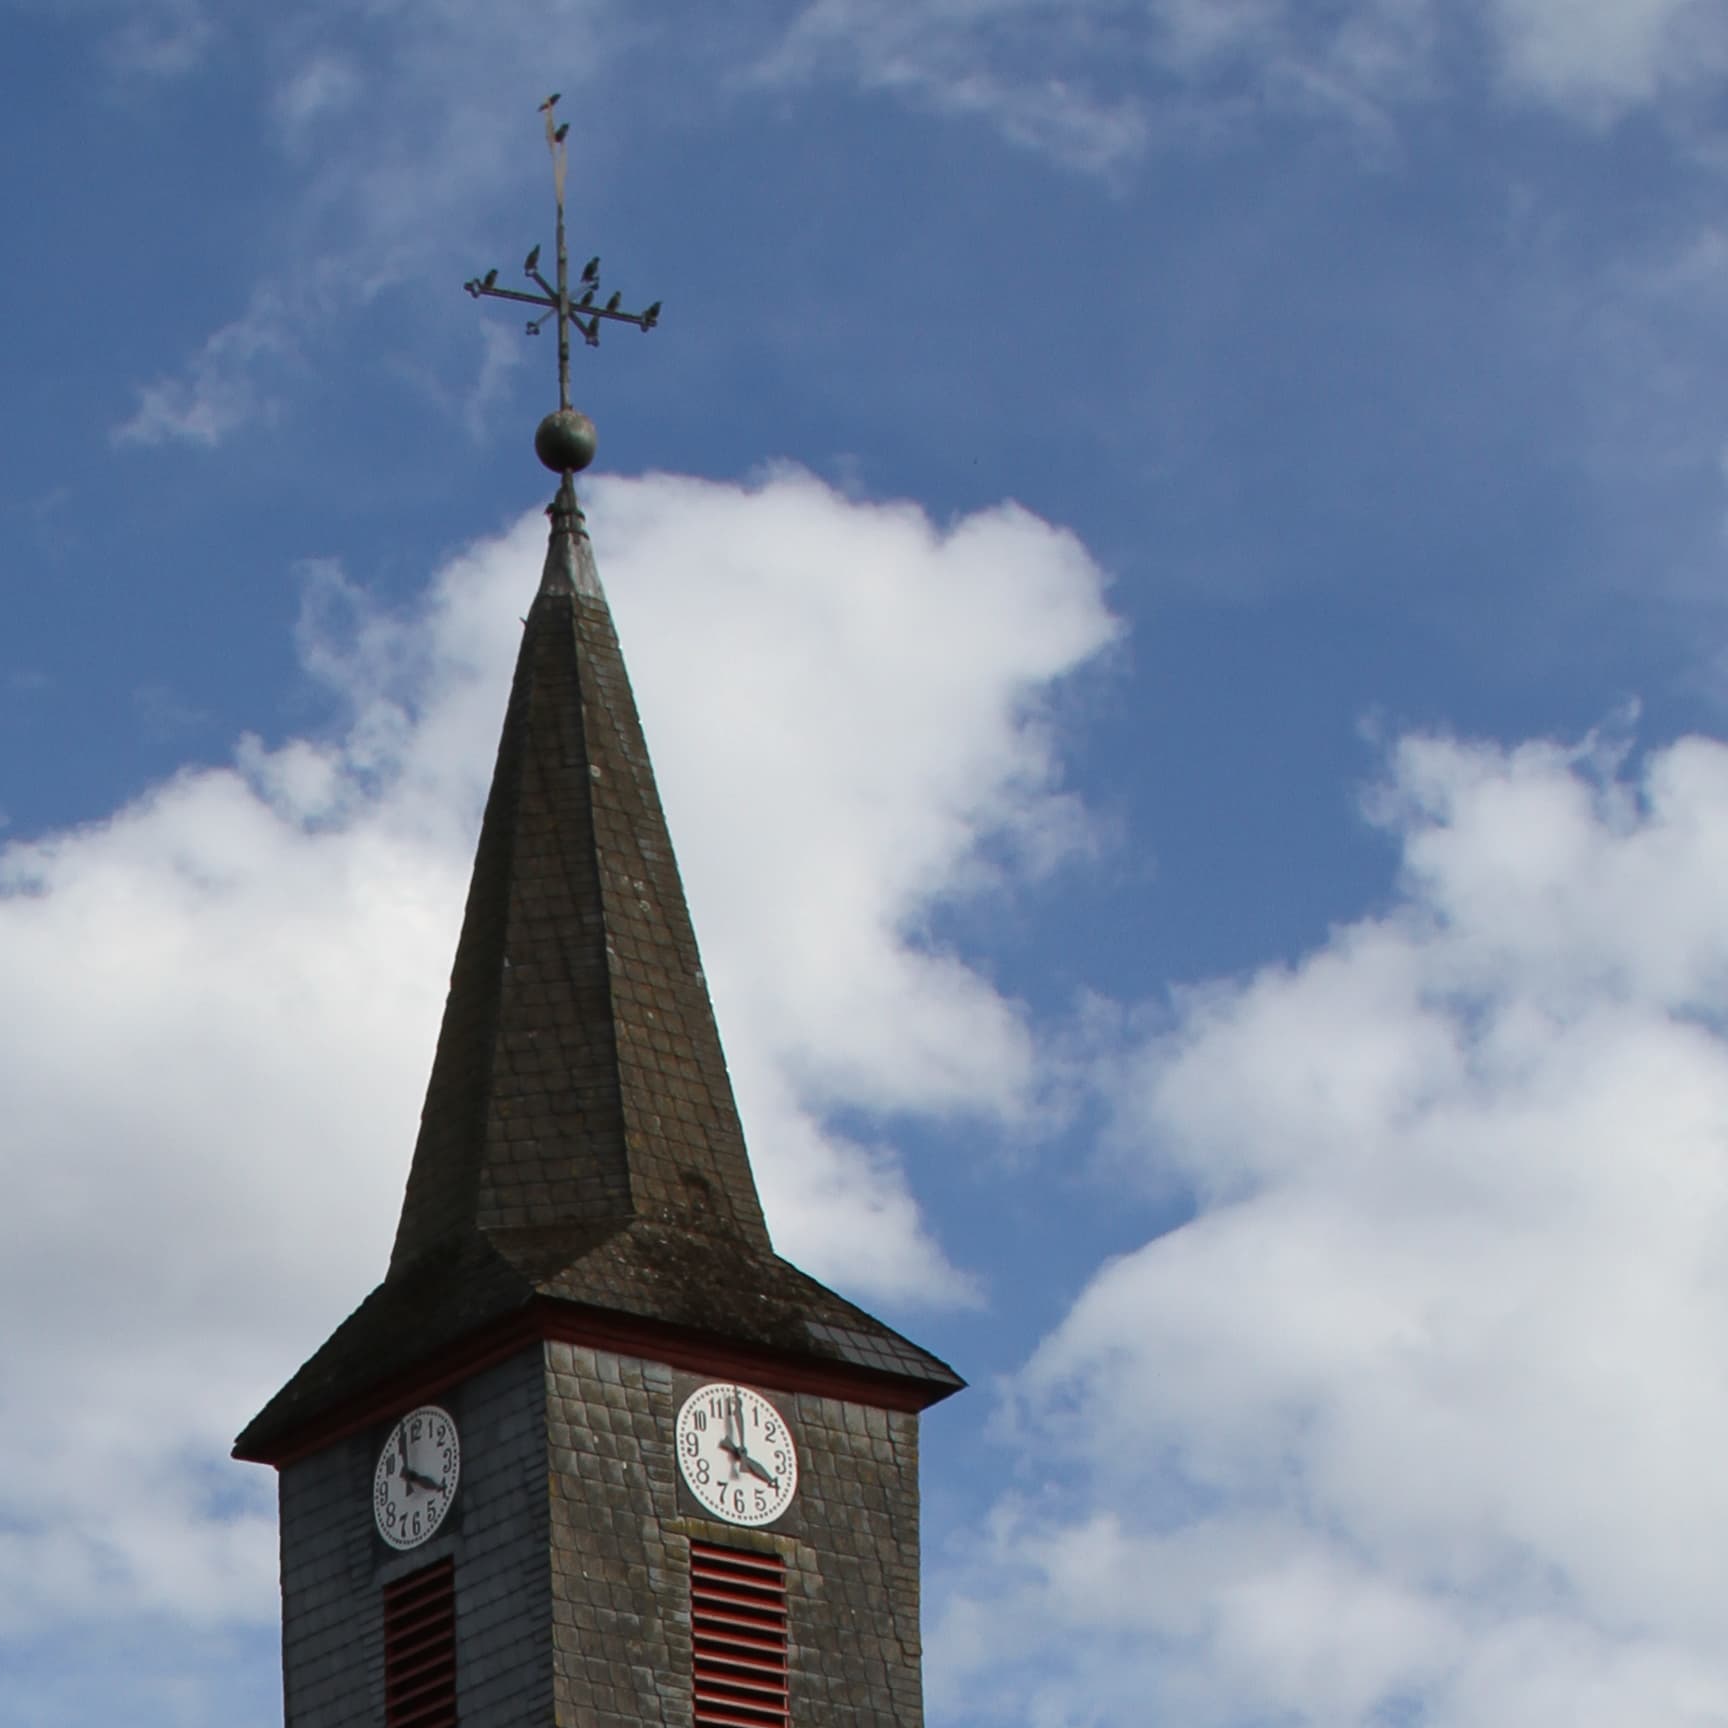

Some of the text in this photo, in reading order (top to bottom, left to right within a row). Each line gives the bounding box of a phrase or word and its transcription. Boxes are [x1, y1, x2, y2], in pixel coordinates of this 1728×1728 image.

[709, 1397, 722, 1419] 11
[753, 1405, 759, 1427] 1
[428, 1419, 433, 1439] 1
[693, 1409, 707, 1432] 10
[765, 1421, 776, 1443] 2
[437, 1425, 446, 1447] 2
[686, 1432, 699, 1457] 9
[443, 1448, 452, 1473] 3
[696, 1458, 709, 1484] 8
[774, 1450, 786, 1475] 3
[380, 1481, 388, 1506] 9
[717, 1480, 728, 1504] 7
[768, 1477, 779, 1497] 4
[427, 1499, 436, 1522] 5
[734, 1489, 745, 1513] 6
[754, 1489, 766, 1511] 5
[386, 1502, 396, 1528] 8
[399, 1512, 408, 1538] 7
[413, 1511, 420, 1536] 6
